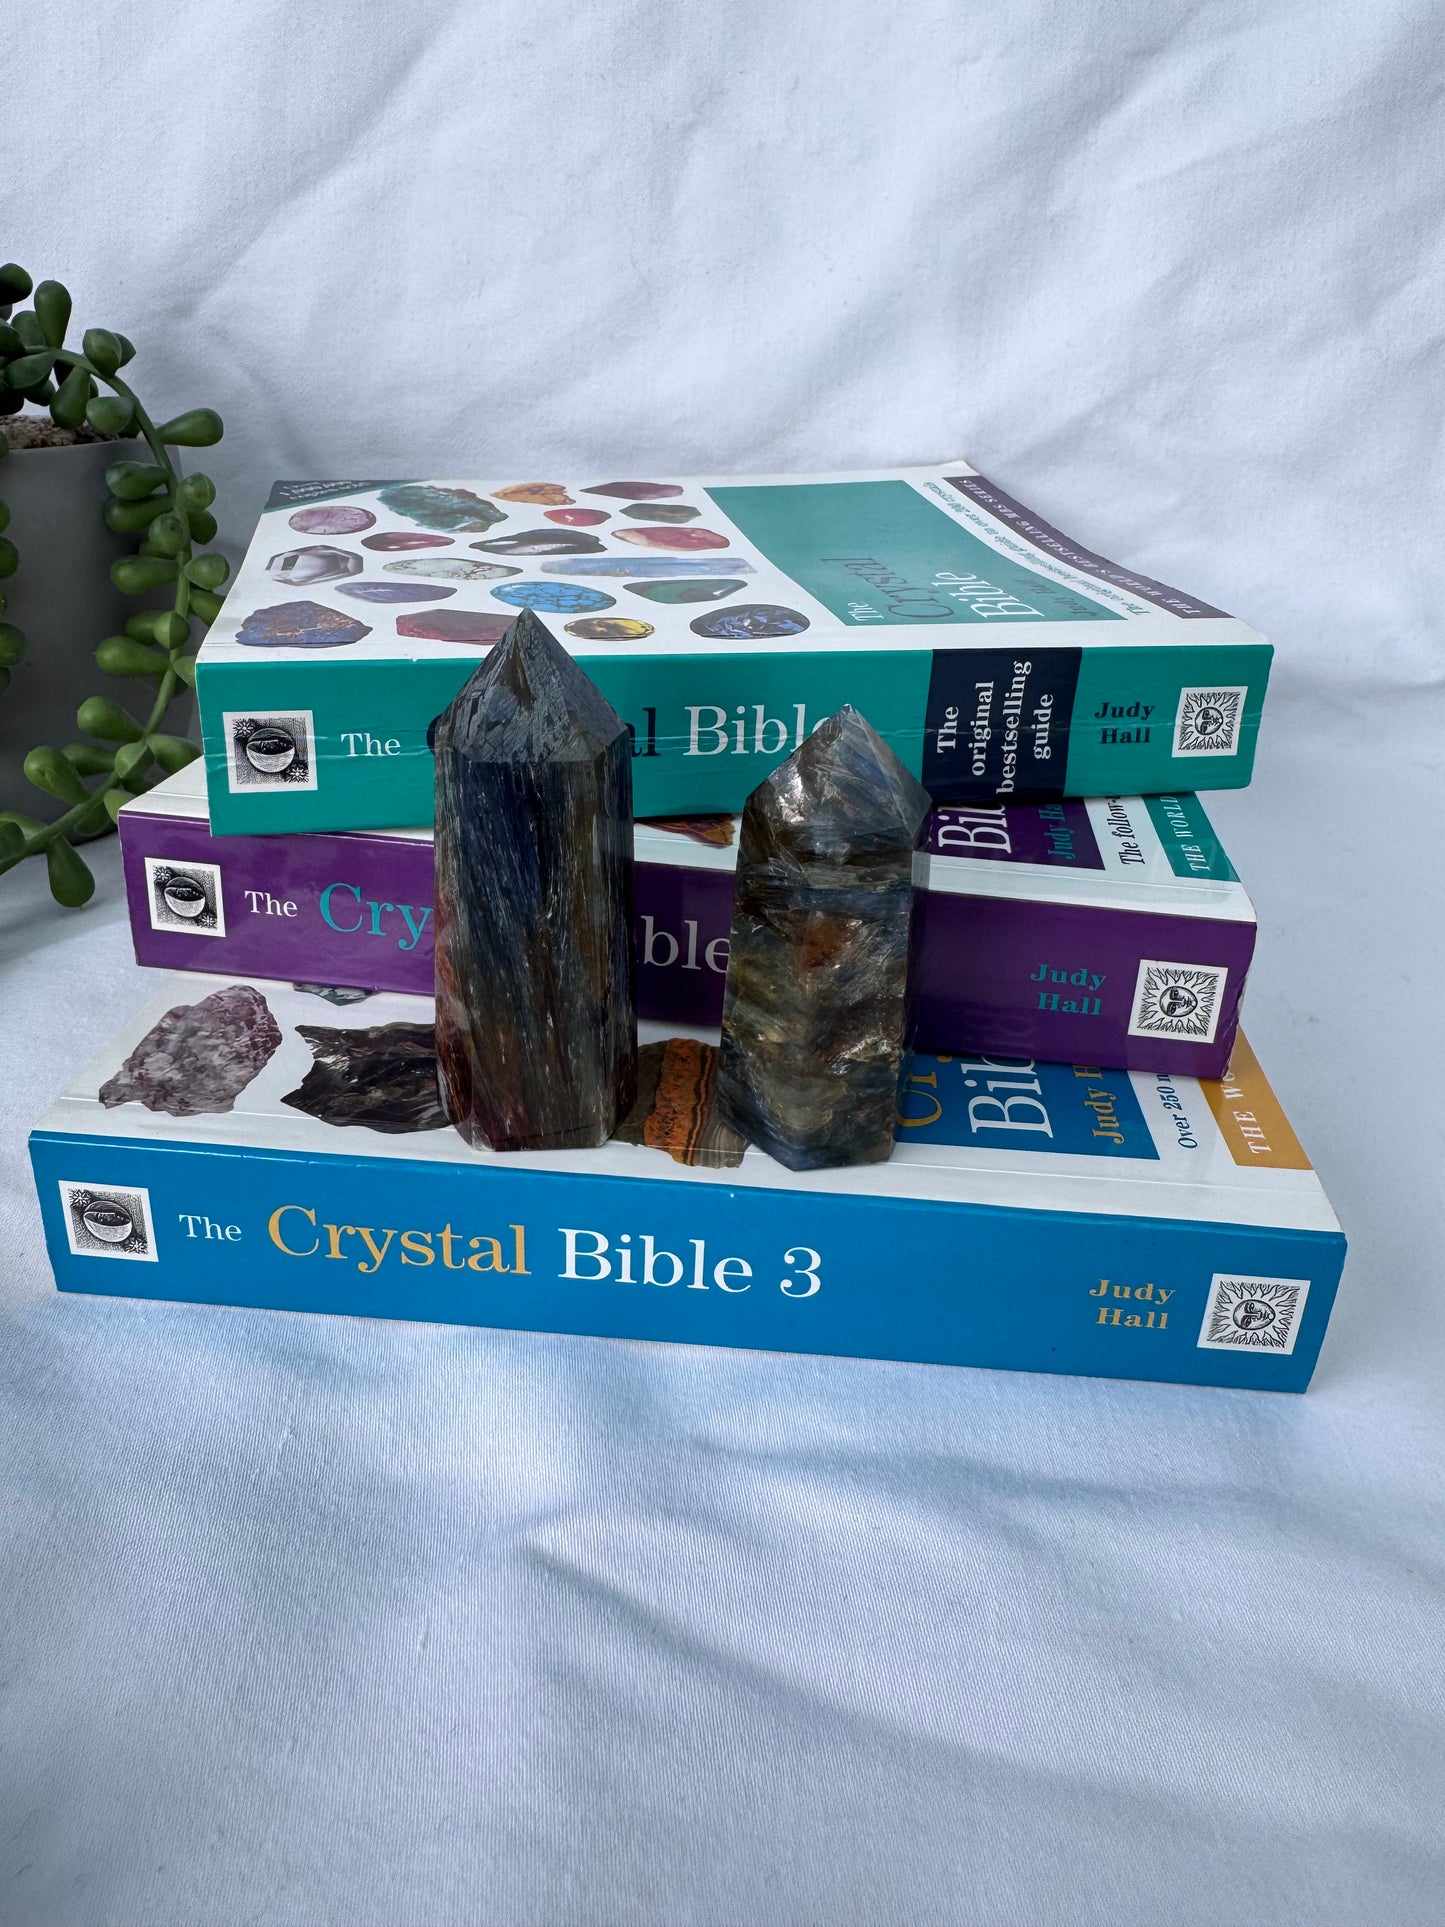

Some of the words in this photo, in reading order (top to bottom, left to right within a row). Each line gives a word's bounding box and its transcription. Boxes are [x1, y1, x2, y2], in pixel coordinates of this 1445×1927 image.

[931, 570, 1045, 619] Bible
[847, 602, 884, 621] The
[1032, 693, 1054, 761] guide
[1094, 702, 1156, 720] Judy
[936, 705, 959, 754] The
[968, 680, 994, 777] original
[996, 660, 1032, 795] bestselling
[1099, 727, 1152, 745] Hall
[340, 732, 401, 757] The
[1043, 824, 1076, 861] Judy
[1119, 841, 1146, 865] The
[1182, 843, 1211, 872] THE
[244, 890, 298, 918] The
[640, 915, 731, 974] ble
[1030, 963, 1106, 990] Judy
[1037, 992, 1102, 1016] Hall
[1156, 1086, 1183, 1111] 250
[1084, 1087, 1126, 1145] Judy
[1173, 1114, 1198, 1149] Over
[1232, 1110, 1272, 1155] THE
[178, 1214, 242, 1242] The
[267, 1204, 532, 1274] Crystal
[557, 1227, 753, 1293] Bible
[779, 1246, 822, 1299] 3
[1089, 1278, 1176, 1305] Judy
[1095, 1306, 1170, 1331] Hall
